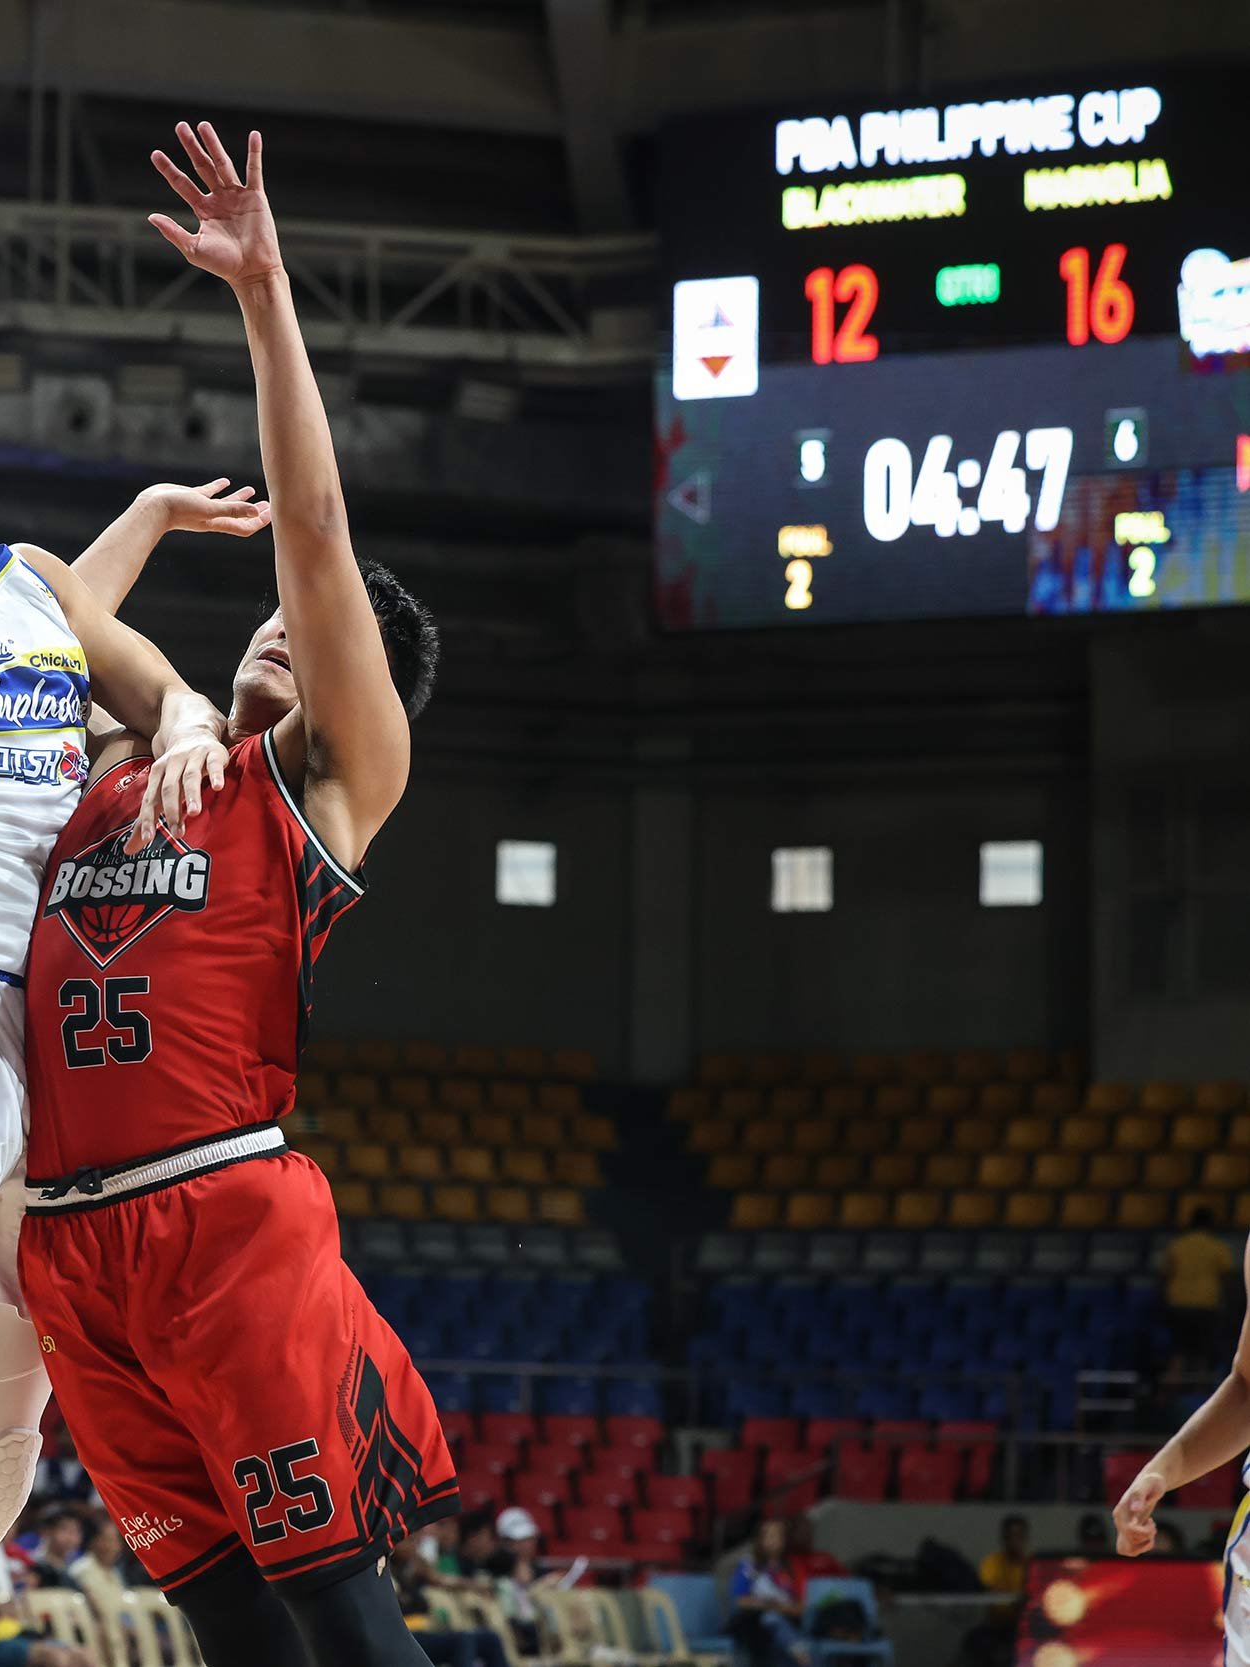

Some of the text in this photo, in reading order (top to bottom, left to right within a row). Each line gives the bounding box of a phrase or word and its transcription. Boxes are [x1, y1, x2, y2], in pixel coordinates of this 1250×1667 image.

[776, 87, 1161, 174] PBA PHILIPPINE CUP
[805, 264, 878, 364] 12
[1060, 243, 1134, 345] 16
[863, 427, 1073, 541] 04:47
[784, 559, 812, 609] 2
[1128, 546, 1156, 597] 2
[47, 850, 209, 906] BOSSING
[58, 976, 152, 1069] 25
[120, 1511, 151, 1534] Ever
[124, 1513, 183, 1552] Organics
[233, 1437, 335, 1546] 25
